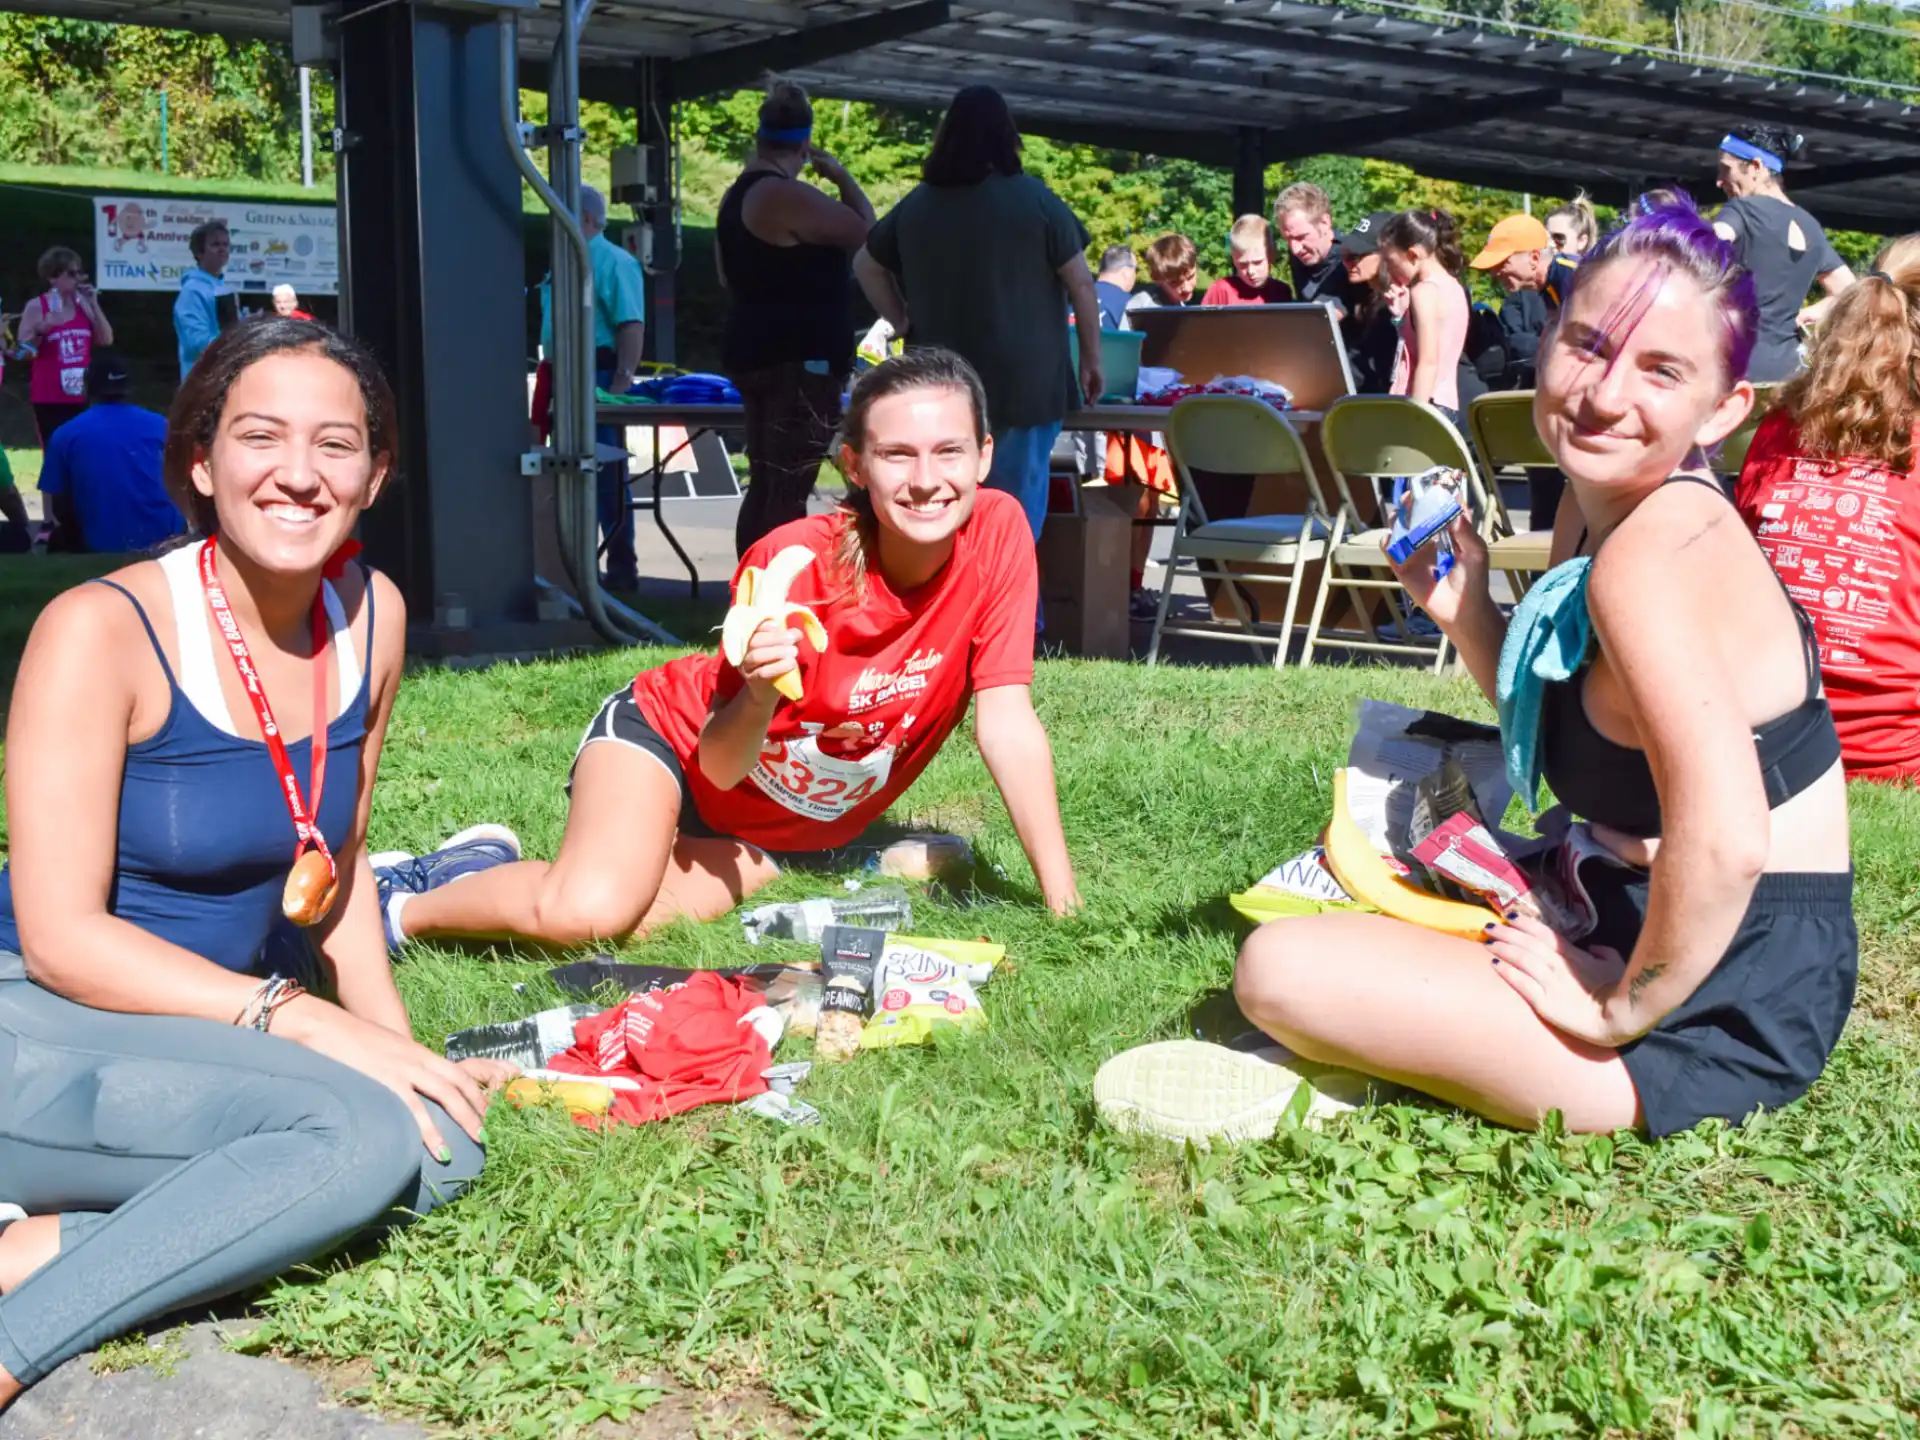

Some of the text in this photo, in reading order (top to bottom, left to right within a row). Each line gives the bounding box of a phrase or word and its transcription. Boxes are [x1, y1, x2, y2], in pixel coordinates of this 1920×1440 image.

[104, 264, 146, 277] TITAN
[849, 694, 873, 709] 5K
[876, 673, 927, 702] BAGEL
[759, 741, 878, 806] 2324
